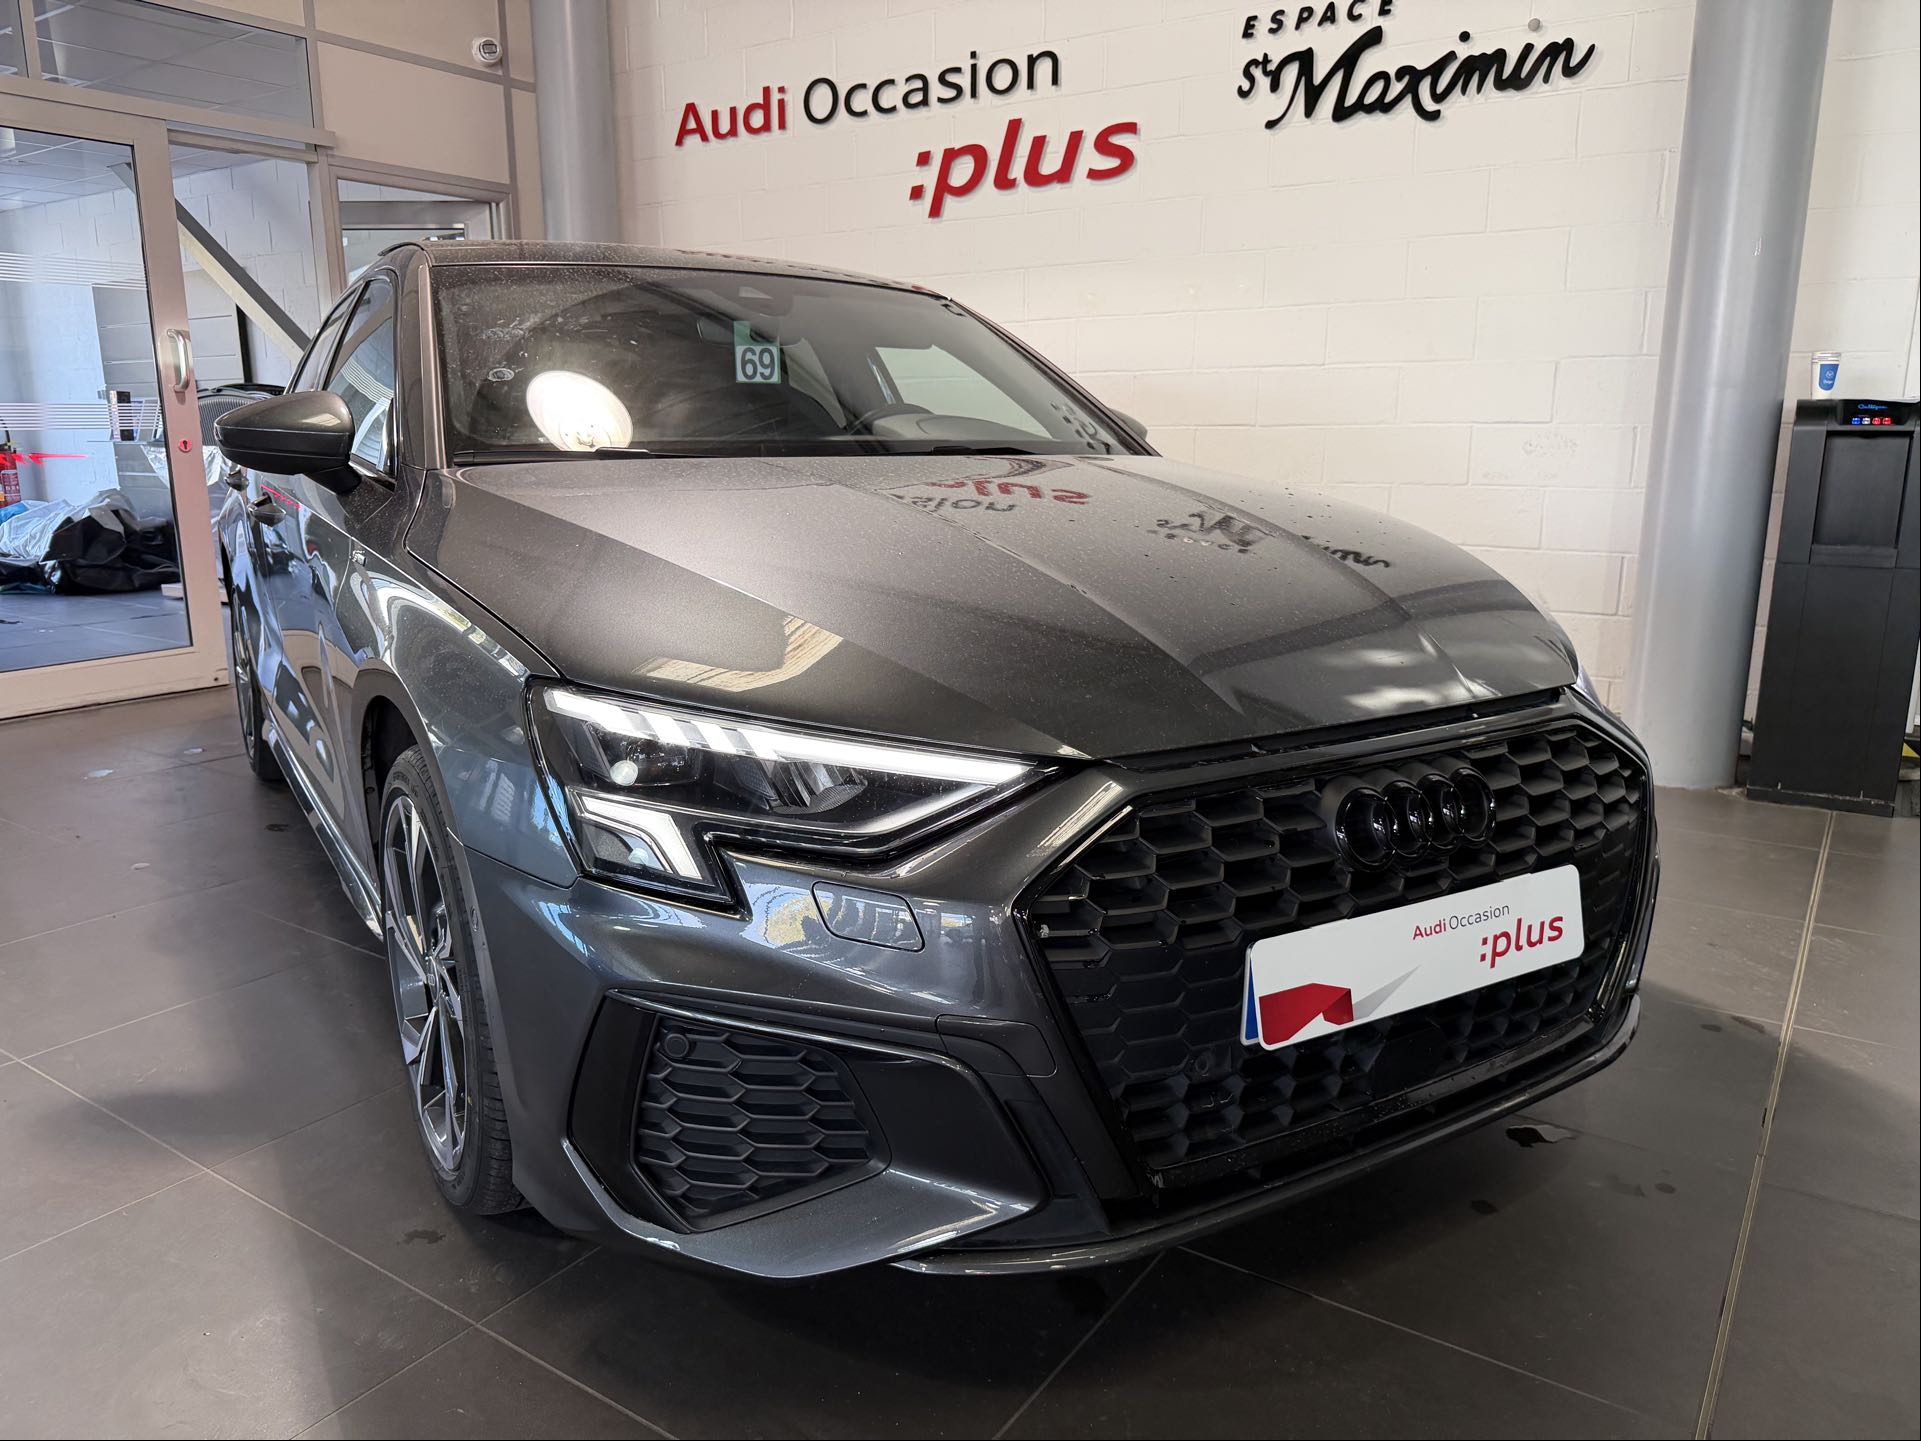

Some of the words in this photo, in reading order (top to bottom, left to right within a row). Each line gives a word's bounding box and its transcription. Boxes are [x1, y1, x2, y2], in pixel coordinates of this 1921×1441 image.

[1242, 0, 1393, 39] ESPACE
[675, 86, 788, 147] Audi
[802, 50, 1060, 125] Occasion
[1264, 25, 1596, 130] Maximin
[909, 118, 1139, 219] :plus
[740, 347, 775, 381] 69
[1412, 918, 1447, 940] Audi
[1448, 903, 1510, 930] Occasion
[1479, 915, 1565, 969] :plus
